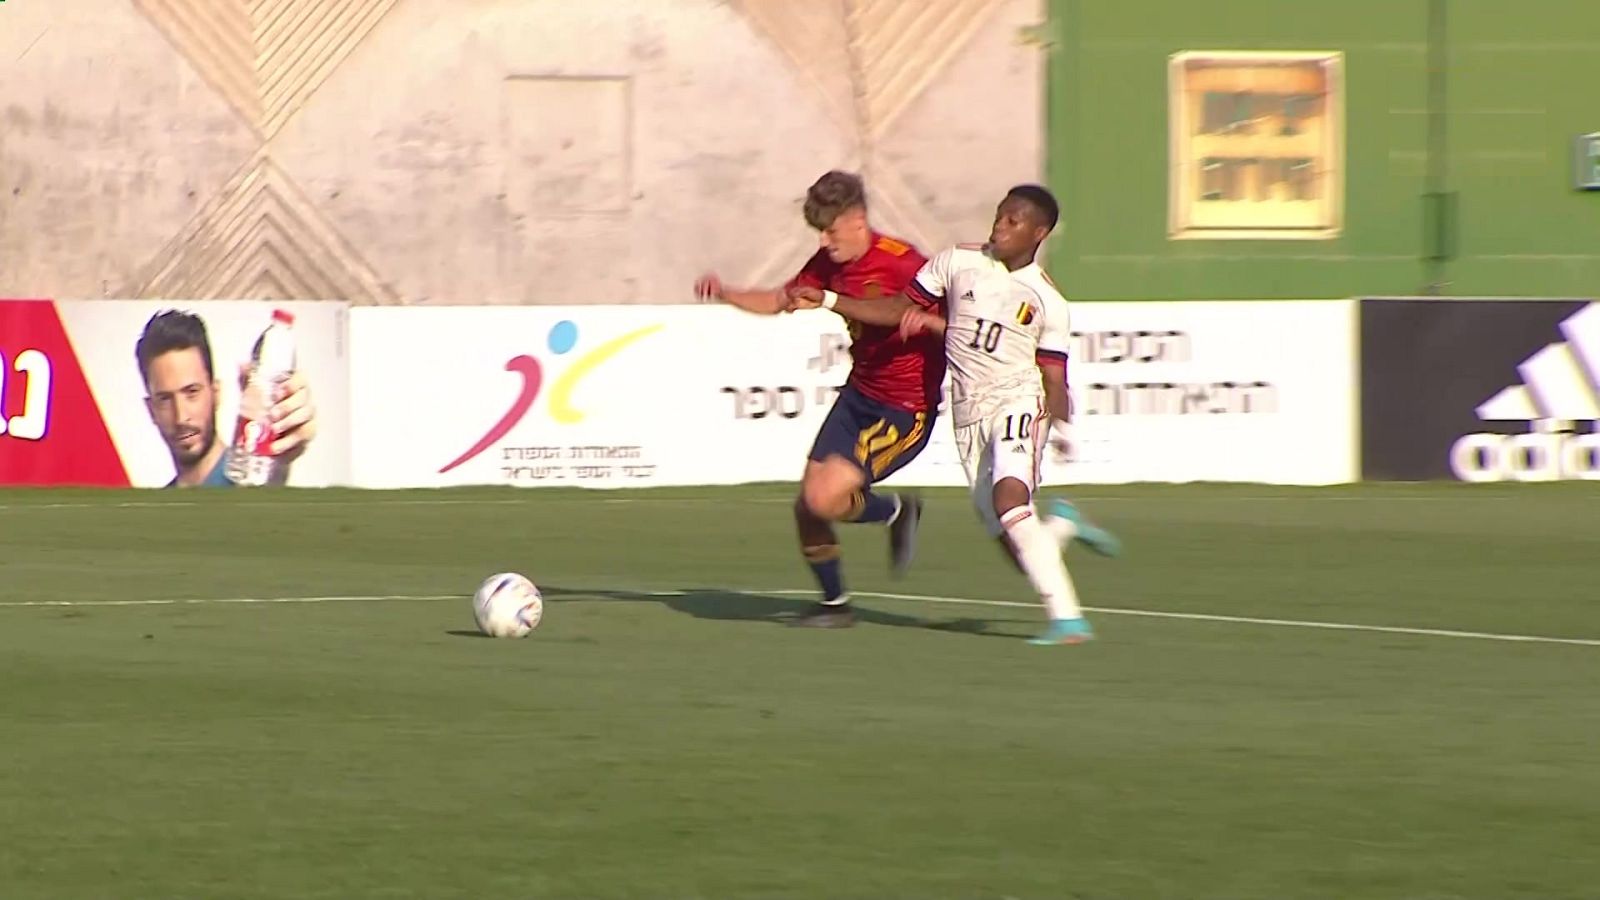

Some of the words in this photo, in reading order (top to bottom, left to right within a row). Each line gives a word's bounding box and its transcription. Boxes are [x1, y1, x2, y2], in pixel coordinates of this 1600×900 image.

[969, 317, 1002, 354] 10
[1069, 330, 1190, 363] הספור
[719, 385, 805, 419] ספר
[1001, 412, 1033, 442] 10
